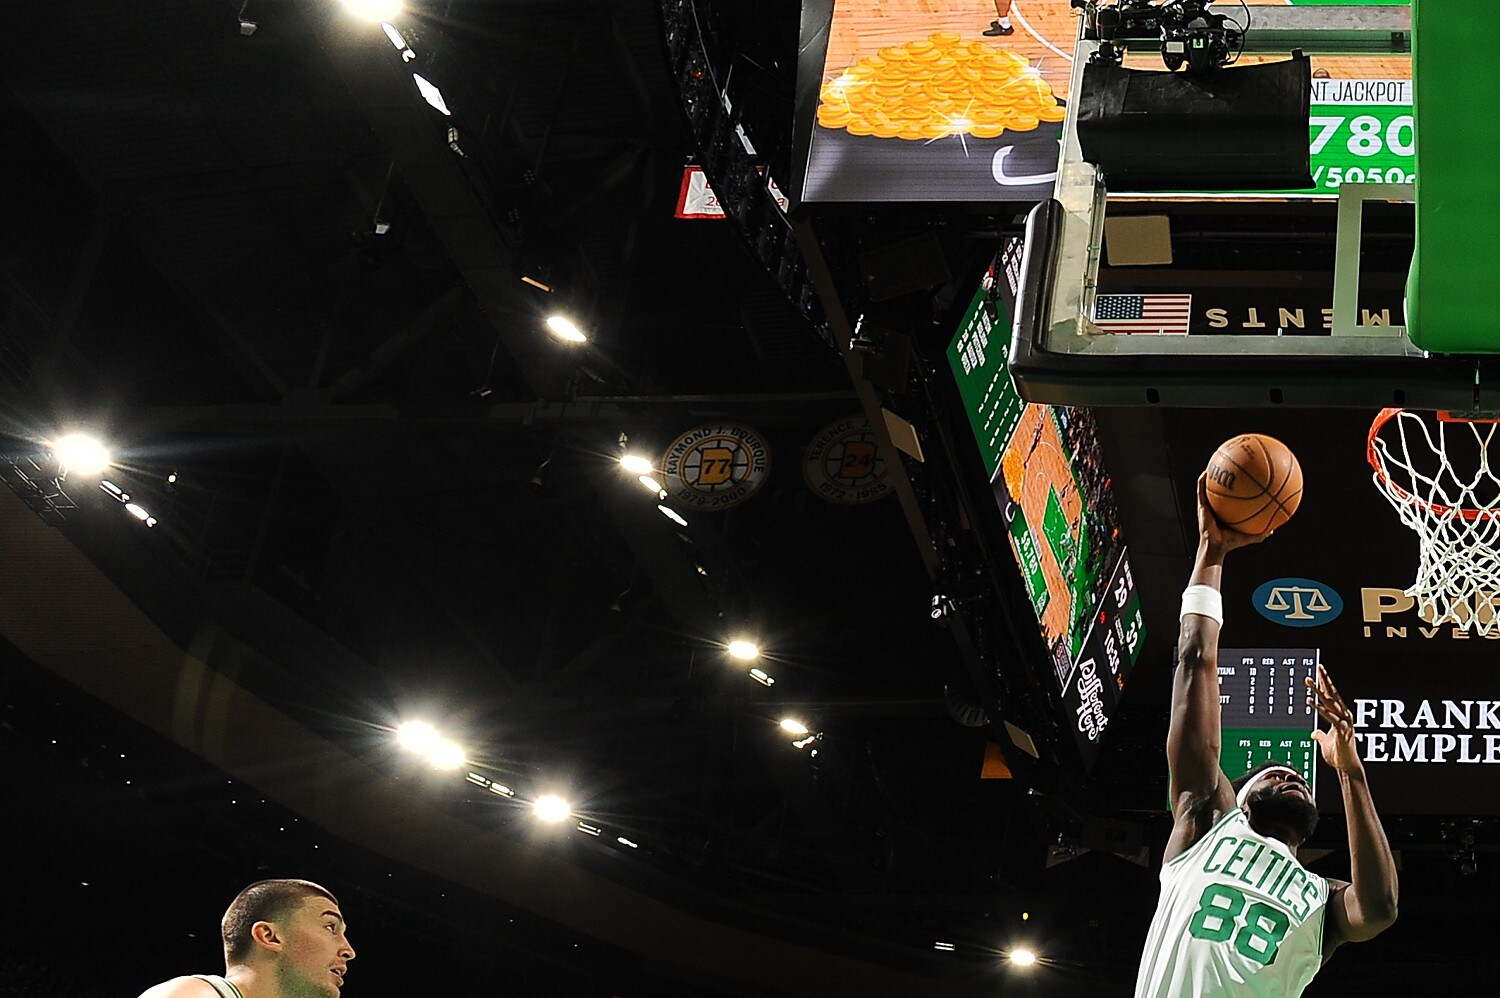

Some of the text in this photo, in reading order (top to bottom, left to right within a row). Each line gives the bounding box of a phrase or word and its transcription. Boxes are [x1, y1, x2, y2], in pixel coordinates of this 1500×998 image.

[1333, 82, 1406, 102] JACKPOT
[667, 427, 765, 474] RAYMOND BOURQUE
[703, 459, 732, 474] 77
[1203, 836, 1319, 922] CELTICS
[1189, 883, 1291, 967] 88
